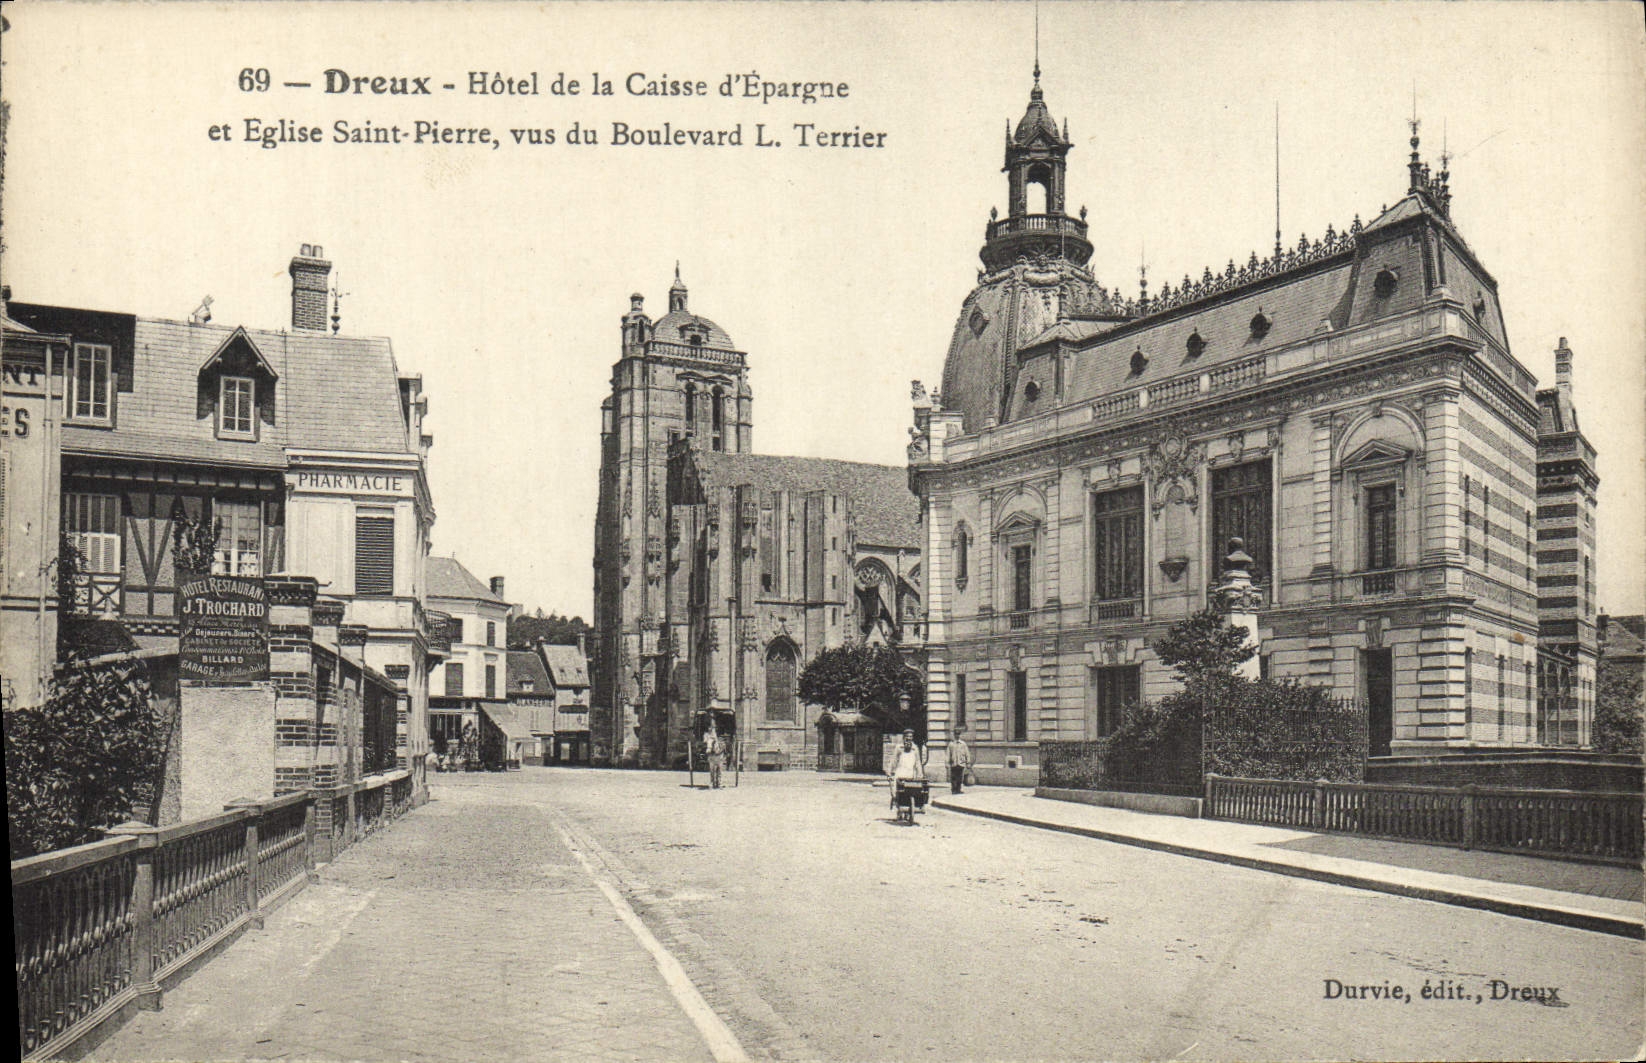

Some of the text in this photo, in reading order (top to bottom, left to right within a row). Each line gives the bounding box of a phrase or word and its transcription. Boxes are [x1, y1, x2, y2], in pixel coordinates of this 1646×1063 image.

[298, 472, 402, 491] PHARMACIE
[195, 598, 265, 617] TROCHARD
[180, 659, 215, 676] GARAGE
[201, 655, 245, 664] BILLARD
